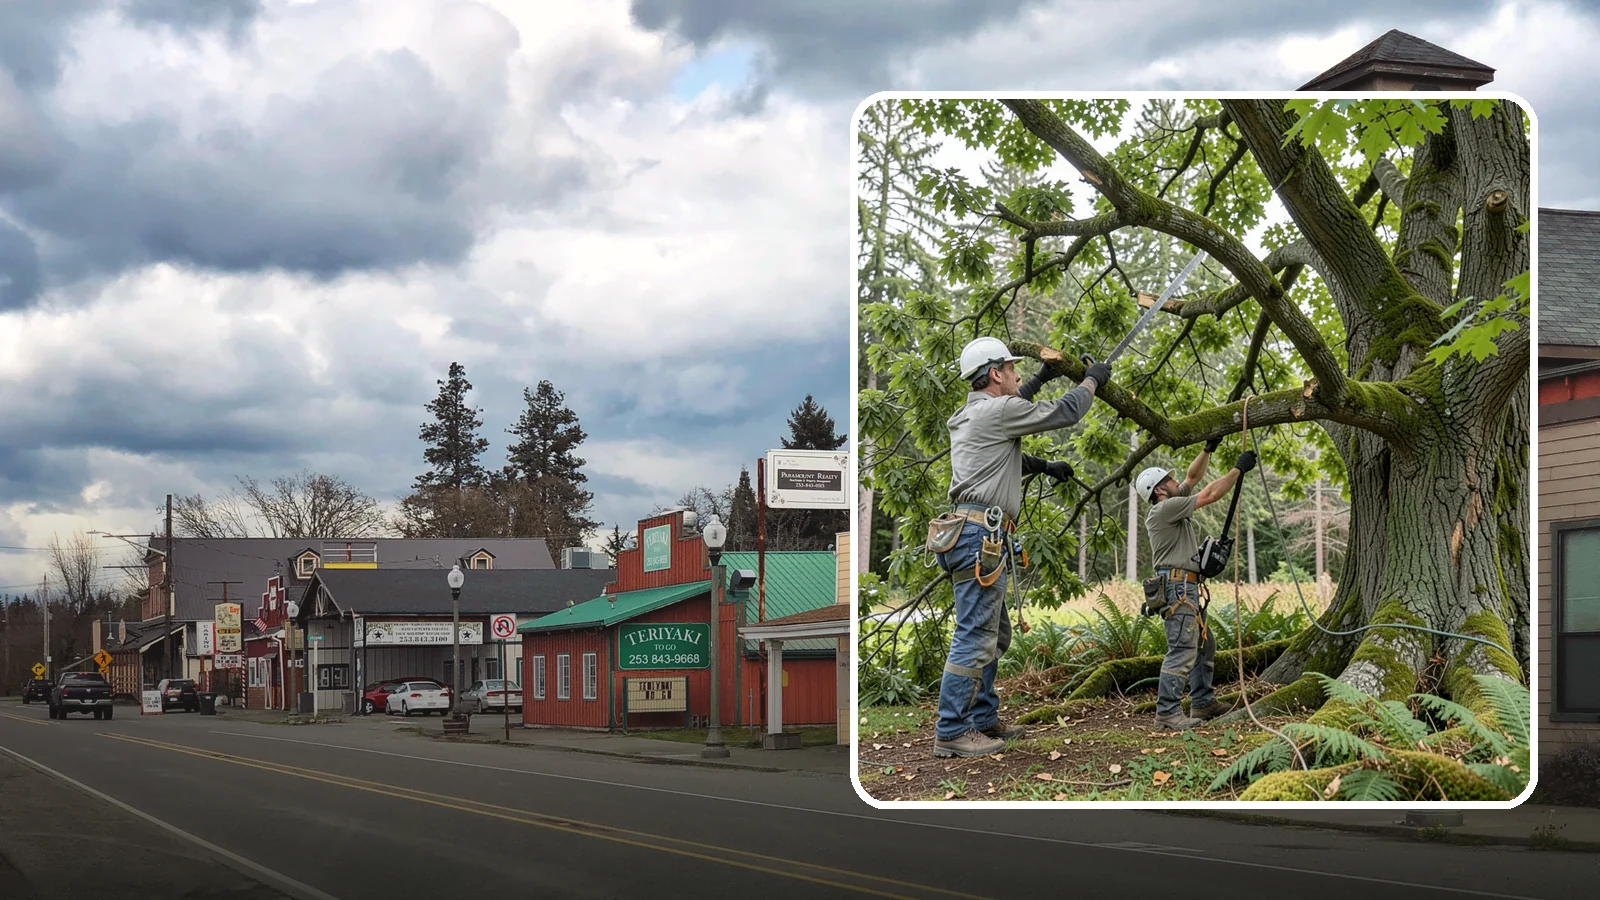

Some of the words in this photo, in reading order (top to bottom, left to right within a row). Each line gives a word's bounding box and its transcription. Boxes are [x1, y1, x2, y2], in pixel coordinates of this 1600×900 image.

[625, 627, 703, 646] TERIYAKI
[629, 654, 648, 664] 253
[651, 654, 700, 664] 843-9668
